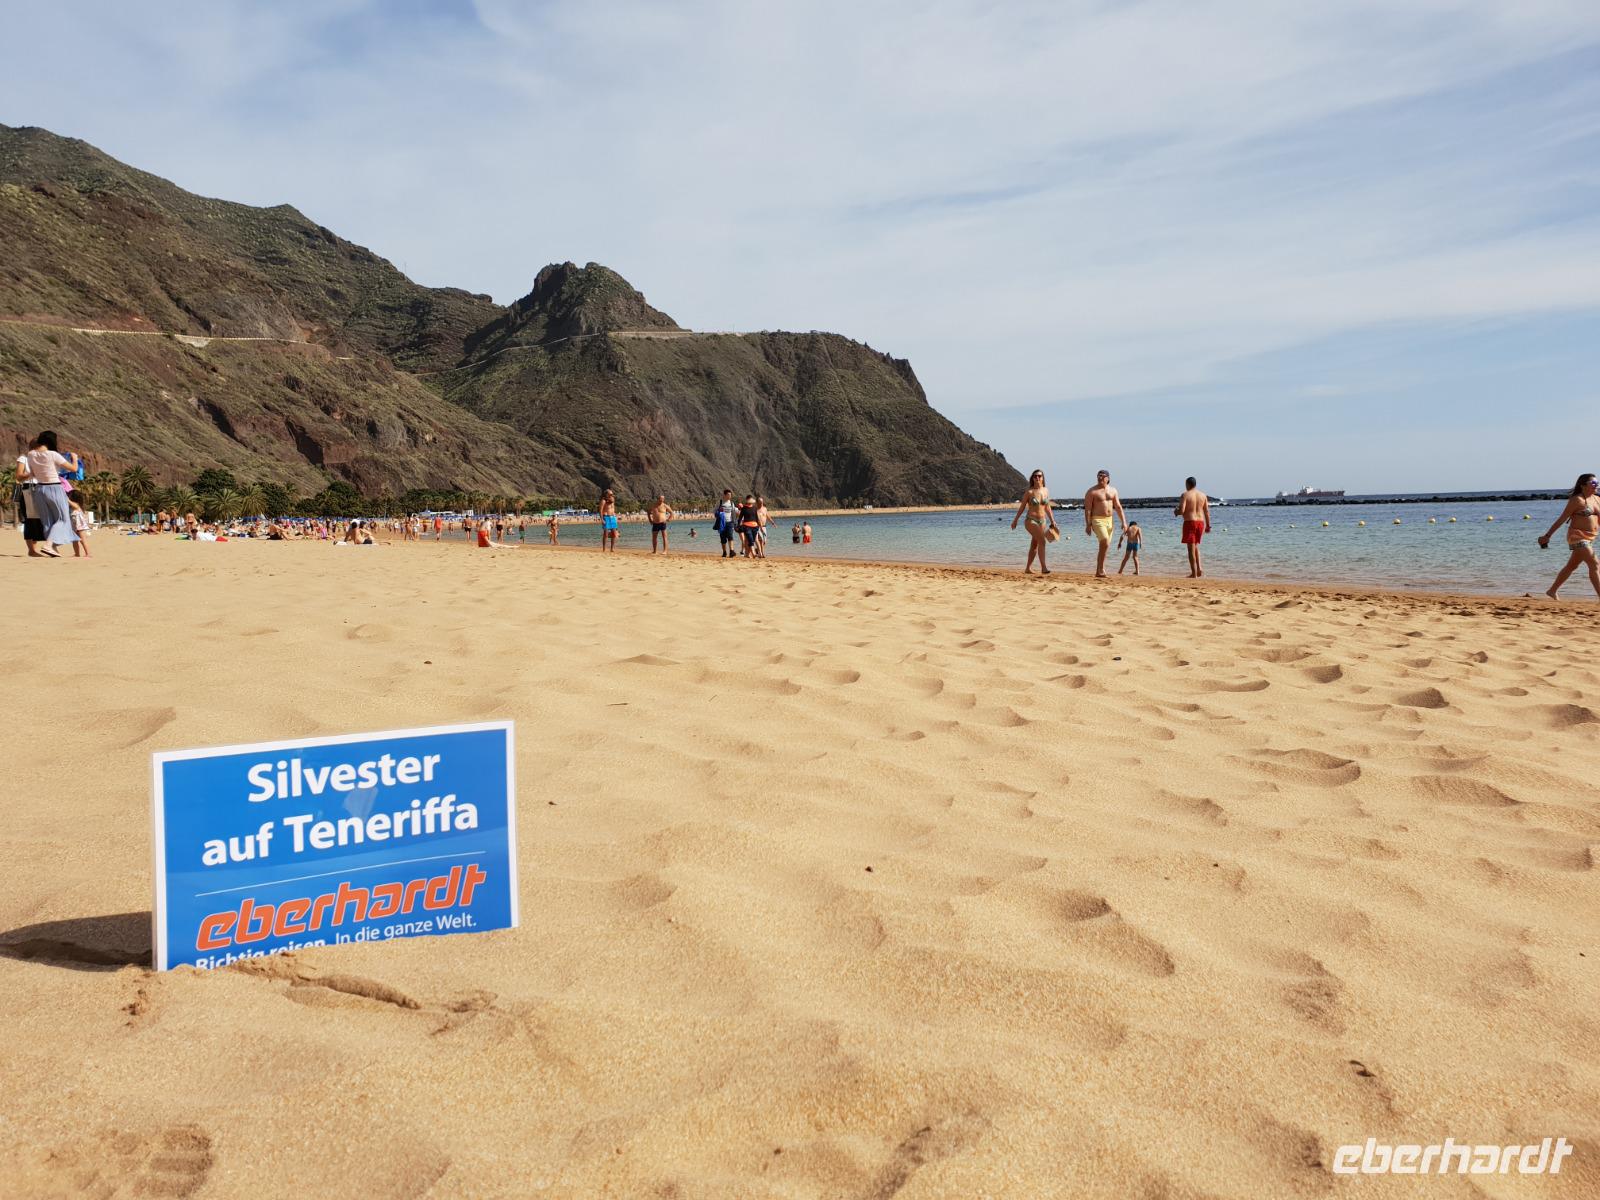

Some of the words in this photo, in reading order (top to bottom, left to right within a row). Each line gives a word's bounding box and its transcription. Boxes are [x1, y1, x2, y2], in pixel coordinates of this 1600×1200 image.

[247, 753, 441, 802] Silvester
[201, 821, 275, 866] auf
[282, 793, 479, 853] Teneriffa
[195, 863, 487, 951] eberhardt
[335, 932, 350, 945] In
[354, 926, 380, 943] die
[383, 919, 433, 939] ganze
[436, 912, 478, 930] Welt.
